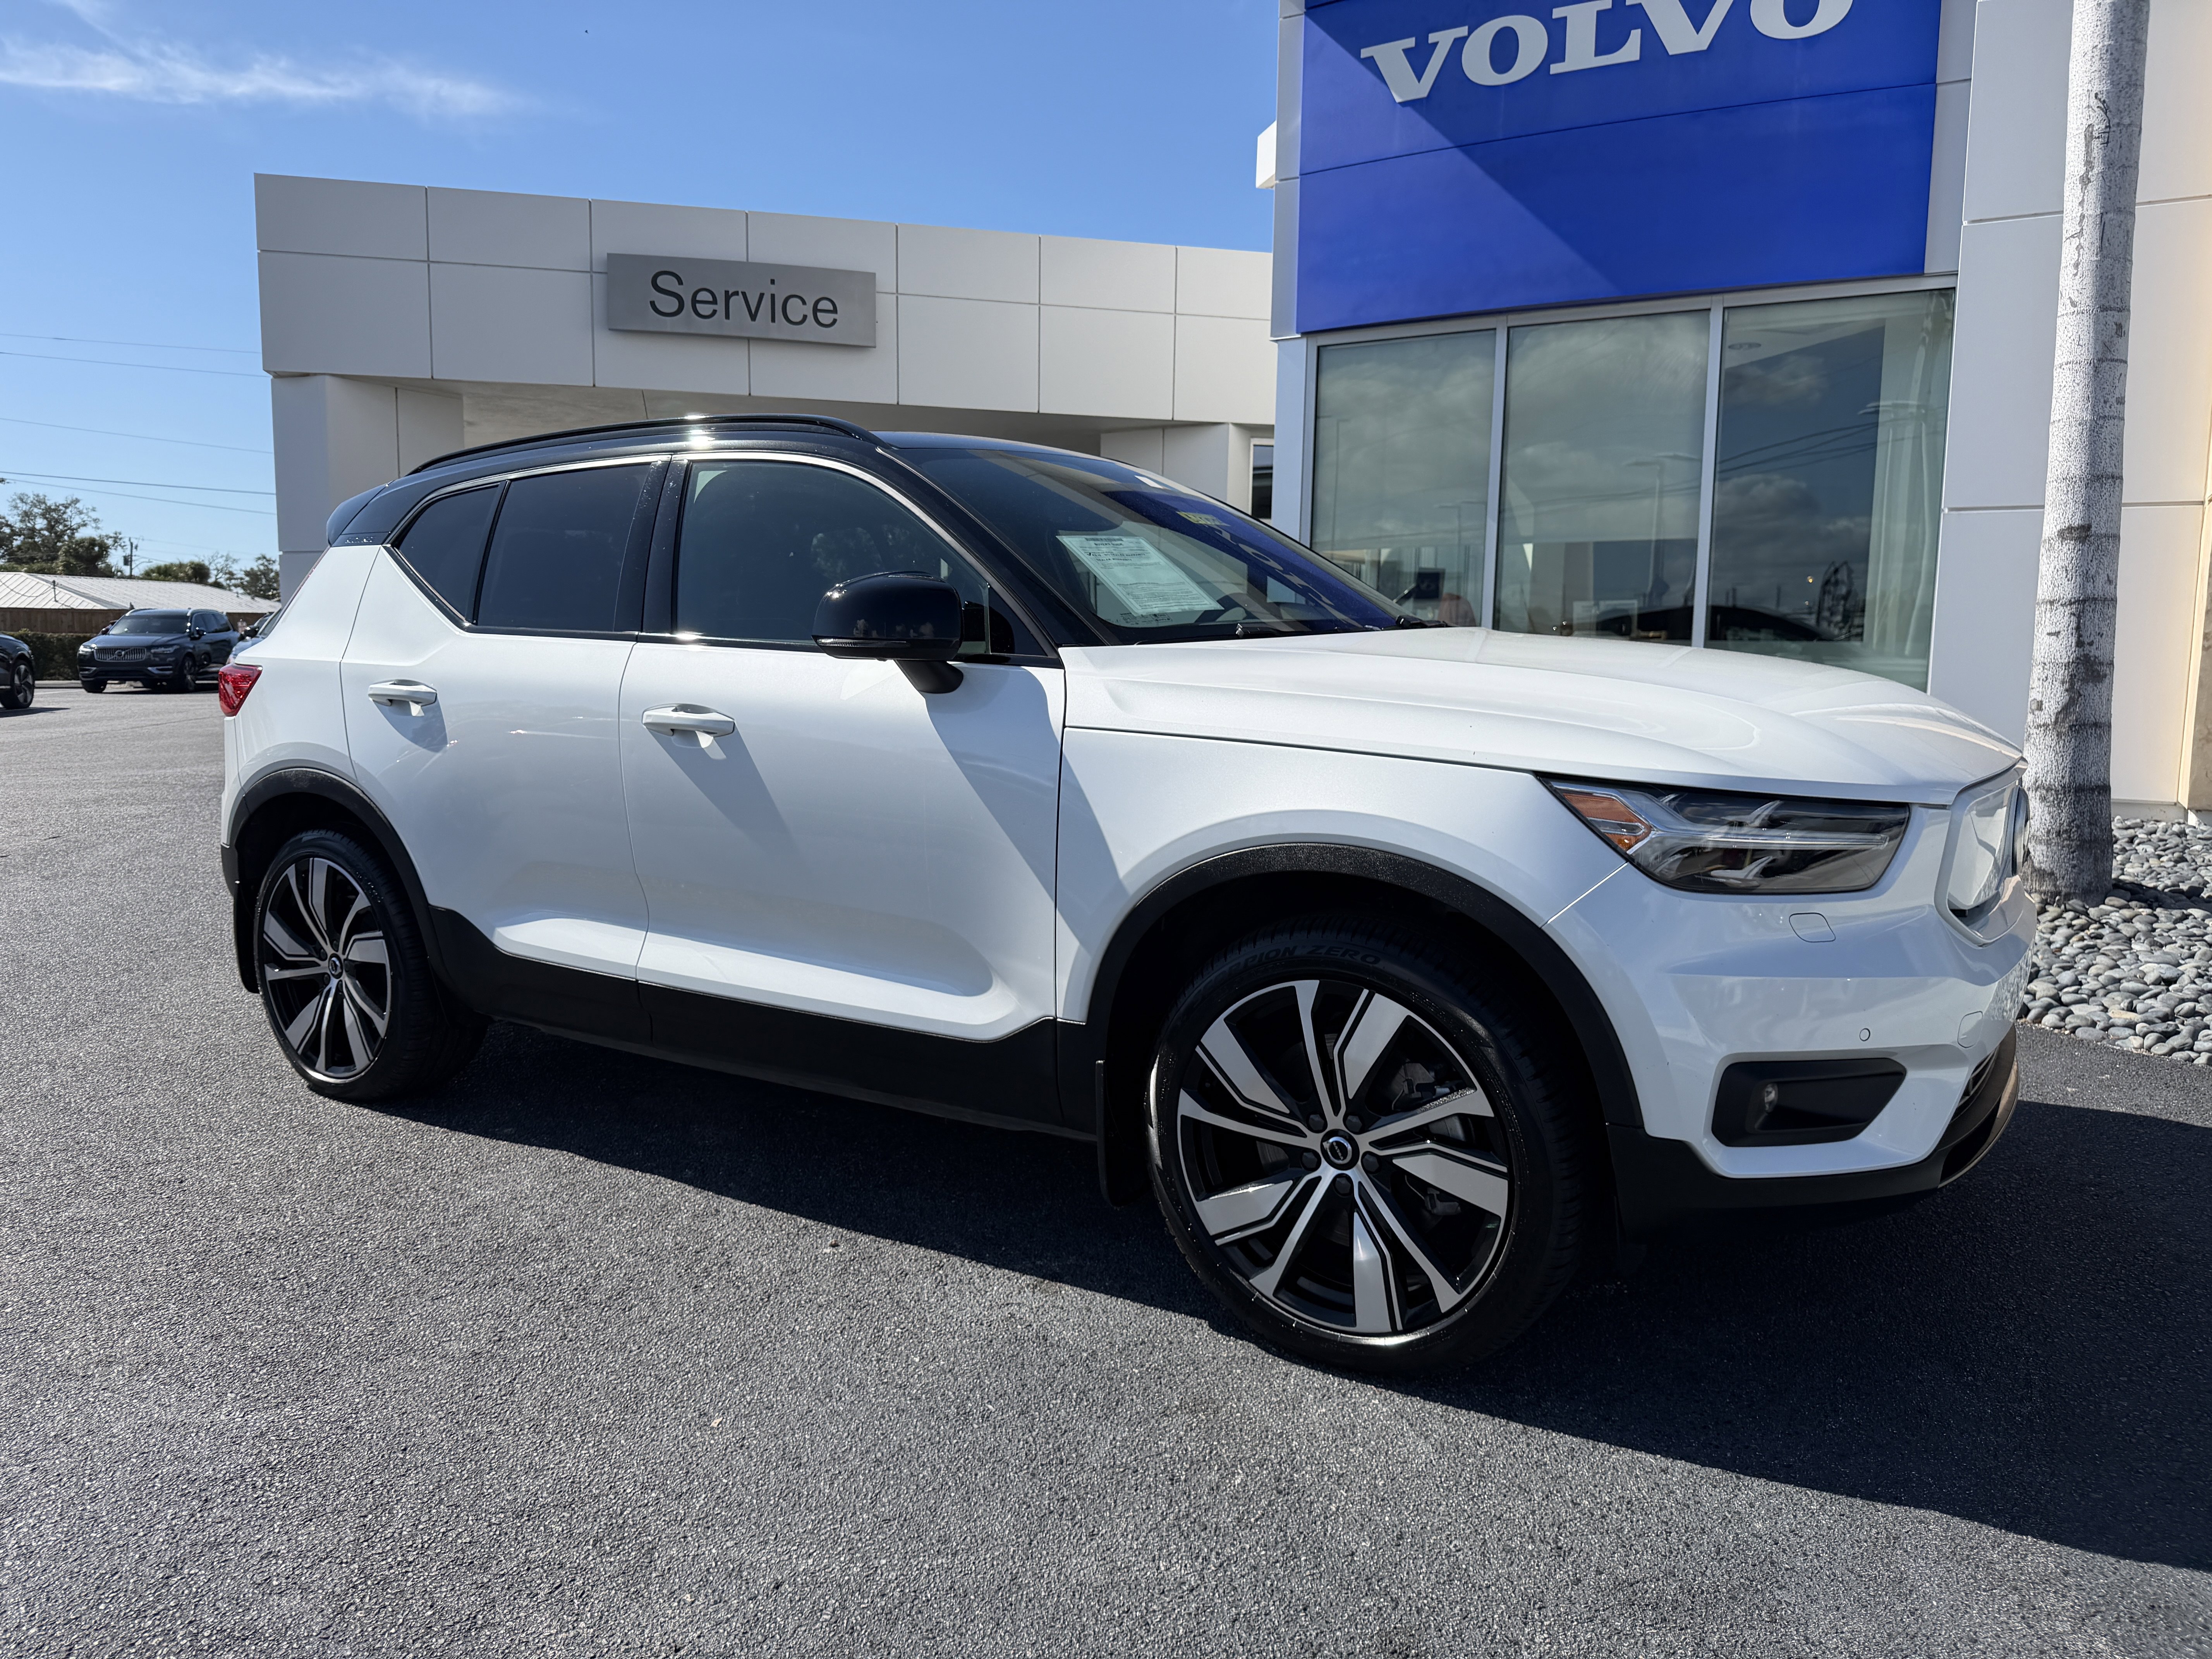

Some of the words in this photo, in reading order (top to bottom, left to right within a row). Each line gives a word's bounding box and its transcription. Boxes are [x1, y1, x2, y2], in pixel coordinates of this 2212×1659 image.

[1360, 0, 1853, 103] VOLVO
[649, 270, 838, 328] Service
[1307, 945, 1381, 965] ZERO
